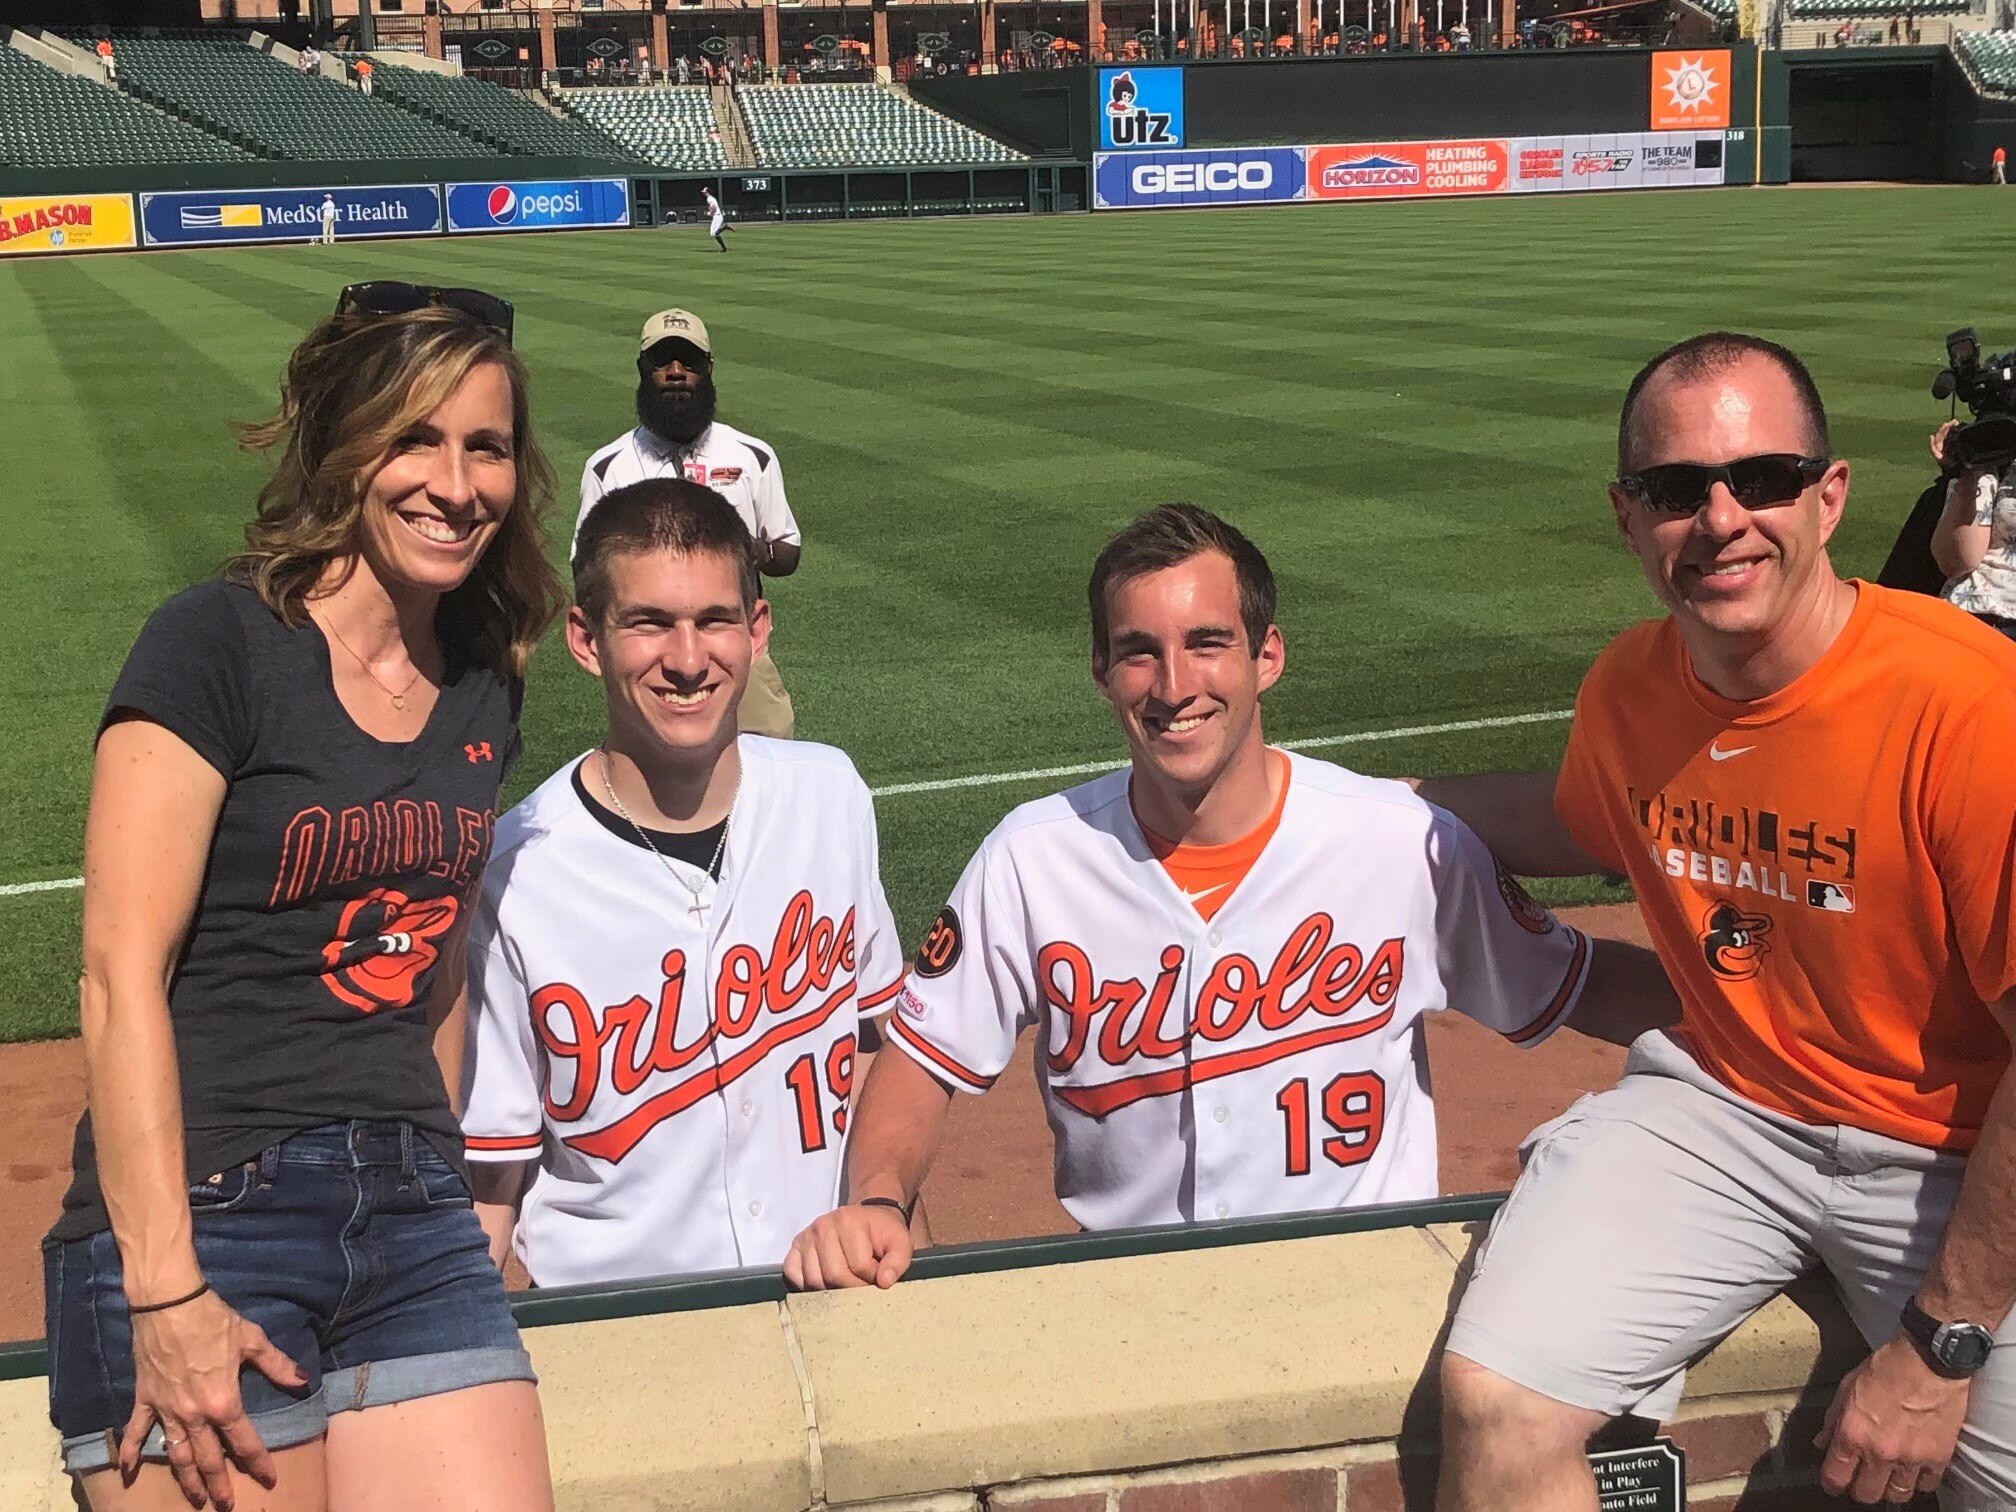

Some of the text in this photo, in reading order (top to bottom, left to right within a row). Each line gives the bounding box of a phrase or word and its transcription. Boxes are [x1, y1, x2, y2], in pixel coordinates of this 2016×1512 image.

[1112, 109, 1169, 144] utz
[1726, 131, 1745, 141] 318
[1425, 146, 1487, 160] HEATING
[1641, 146, 1692, 160] THE TEAM
[1656, 157, 1678, 166] 980
[1425, 160, 1498, 174] PLUMBING
[746, 179, 767, 191] 373
[1132, 161, 1273, 194] GEICO
[1324, 168, 1418, 187] HORIZON
[1425, 174, 1487, 188] COOLING
[266, 200, 408, 225] MedStr Health
[521, 190, 581, 219] pepsi
[921, 915, 955, 967] 20
[1038, 911, 1406, 1072] Orioles
[1277, 1069, 1385, 1177] 19
[1593, 1457, 1660, 1474] ot Interfere
[1617, 1476, 1641, 1489] Play
[1602, 1493, 1657, 1510] nto Field
